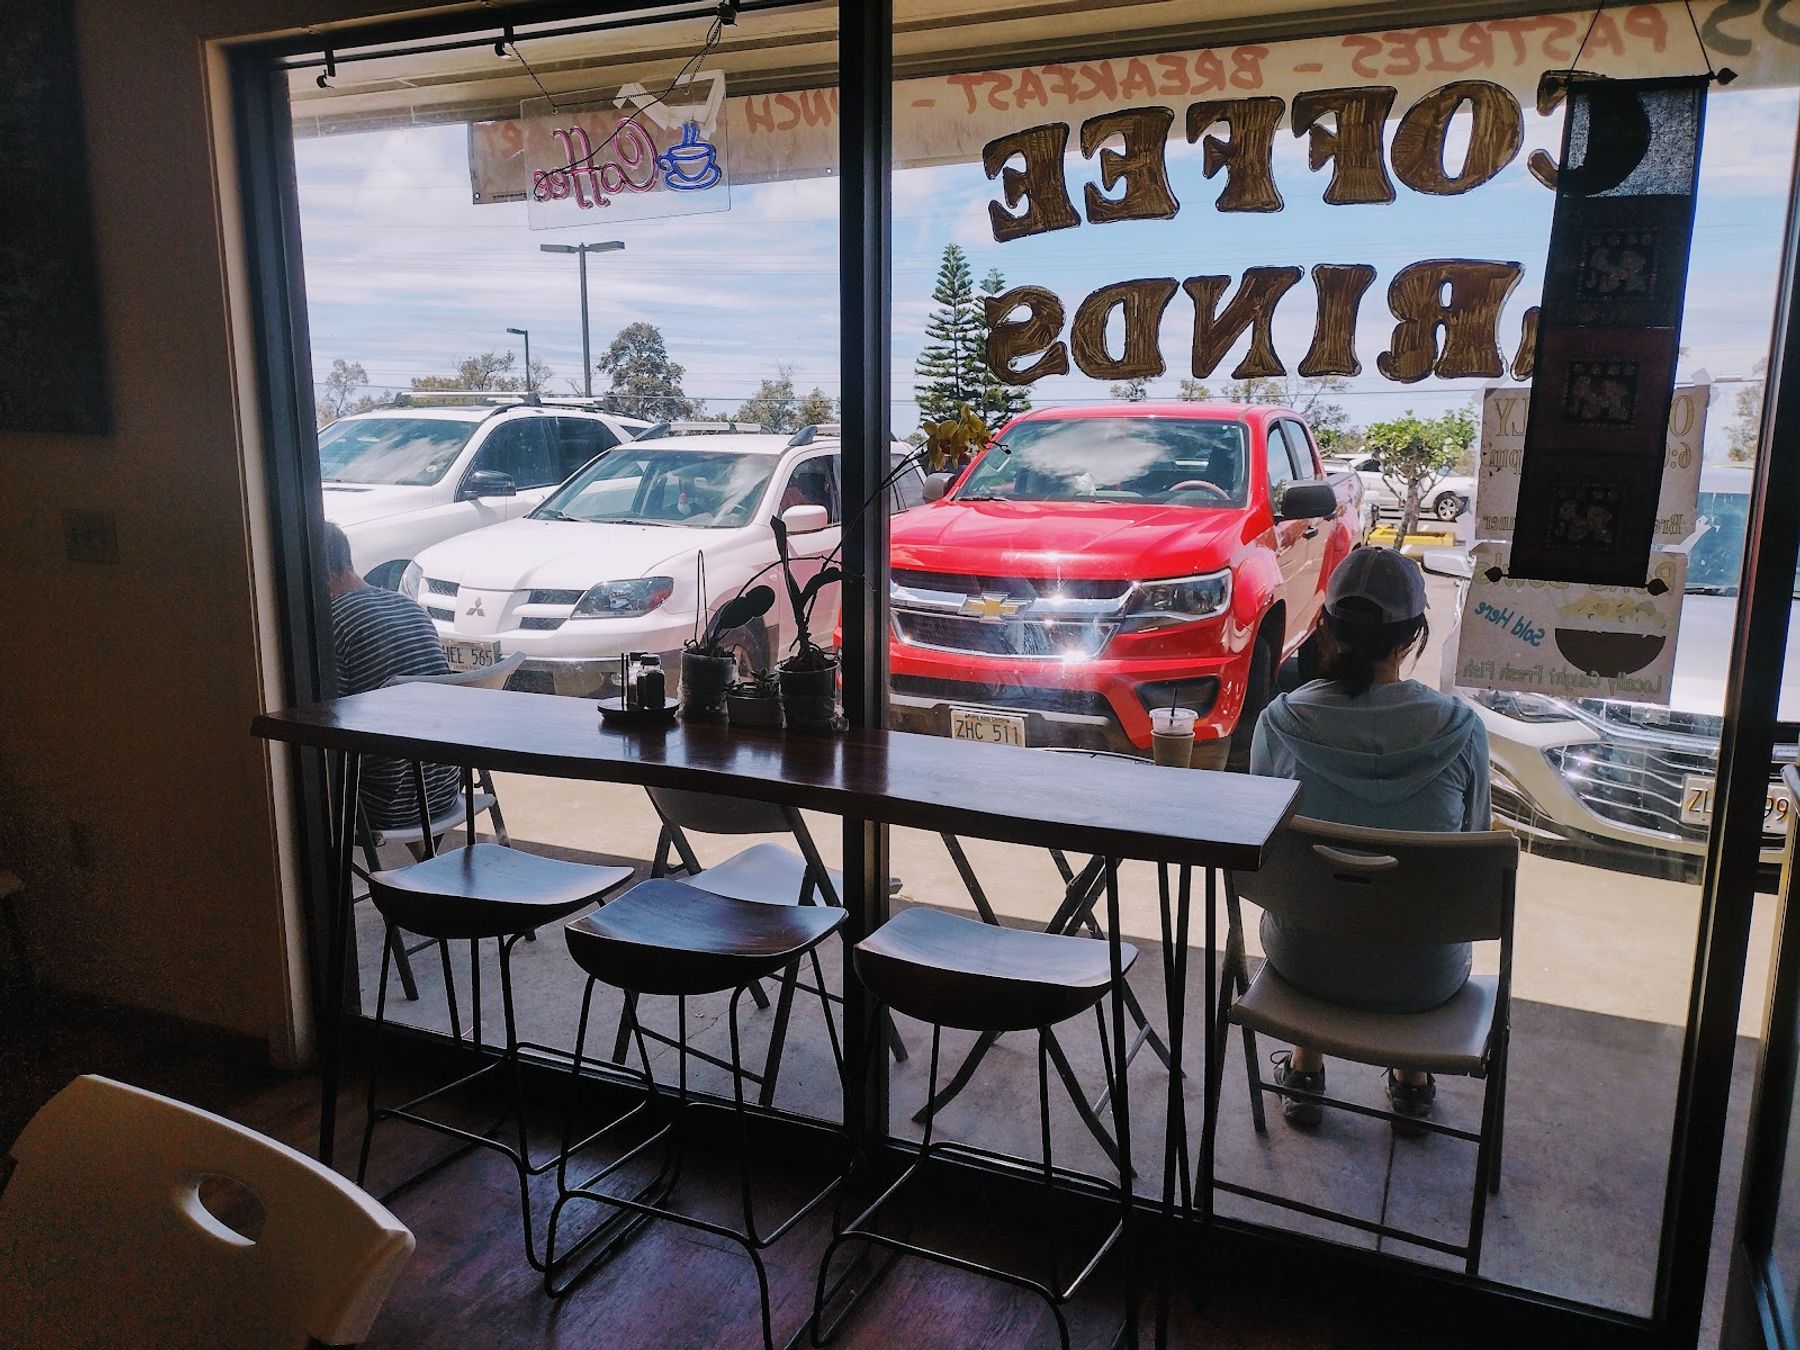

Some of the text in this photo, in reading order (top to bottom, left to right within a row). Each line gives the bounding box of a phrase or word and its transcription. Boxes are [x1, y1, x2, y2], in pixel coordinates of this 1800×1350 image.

[471, 649, 493, 667] 565
[956, 719, 1019, 745] ZHC 511
